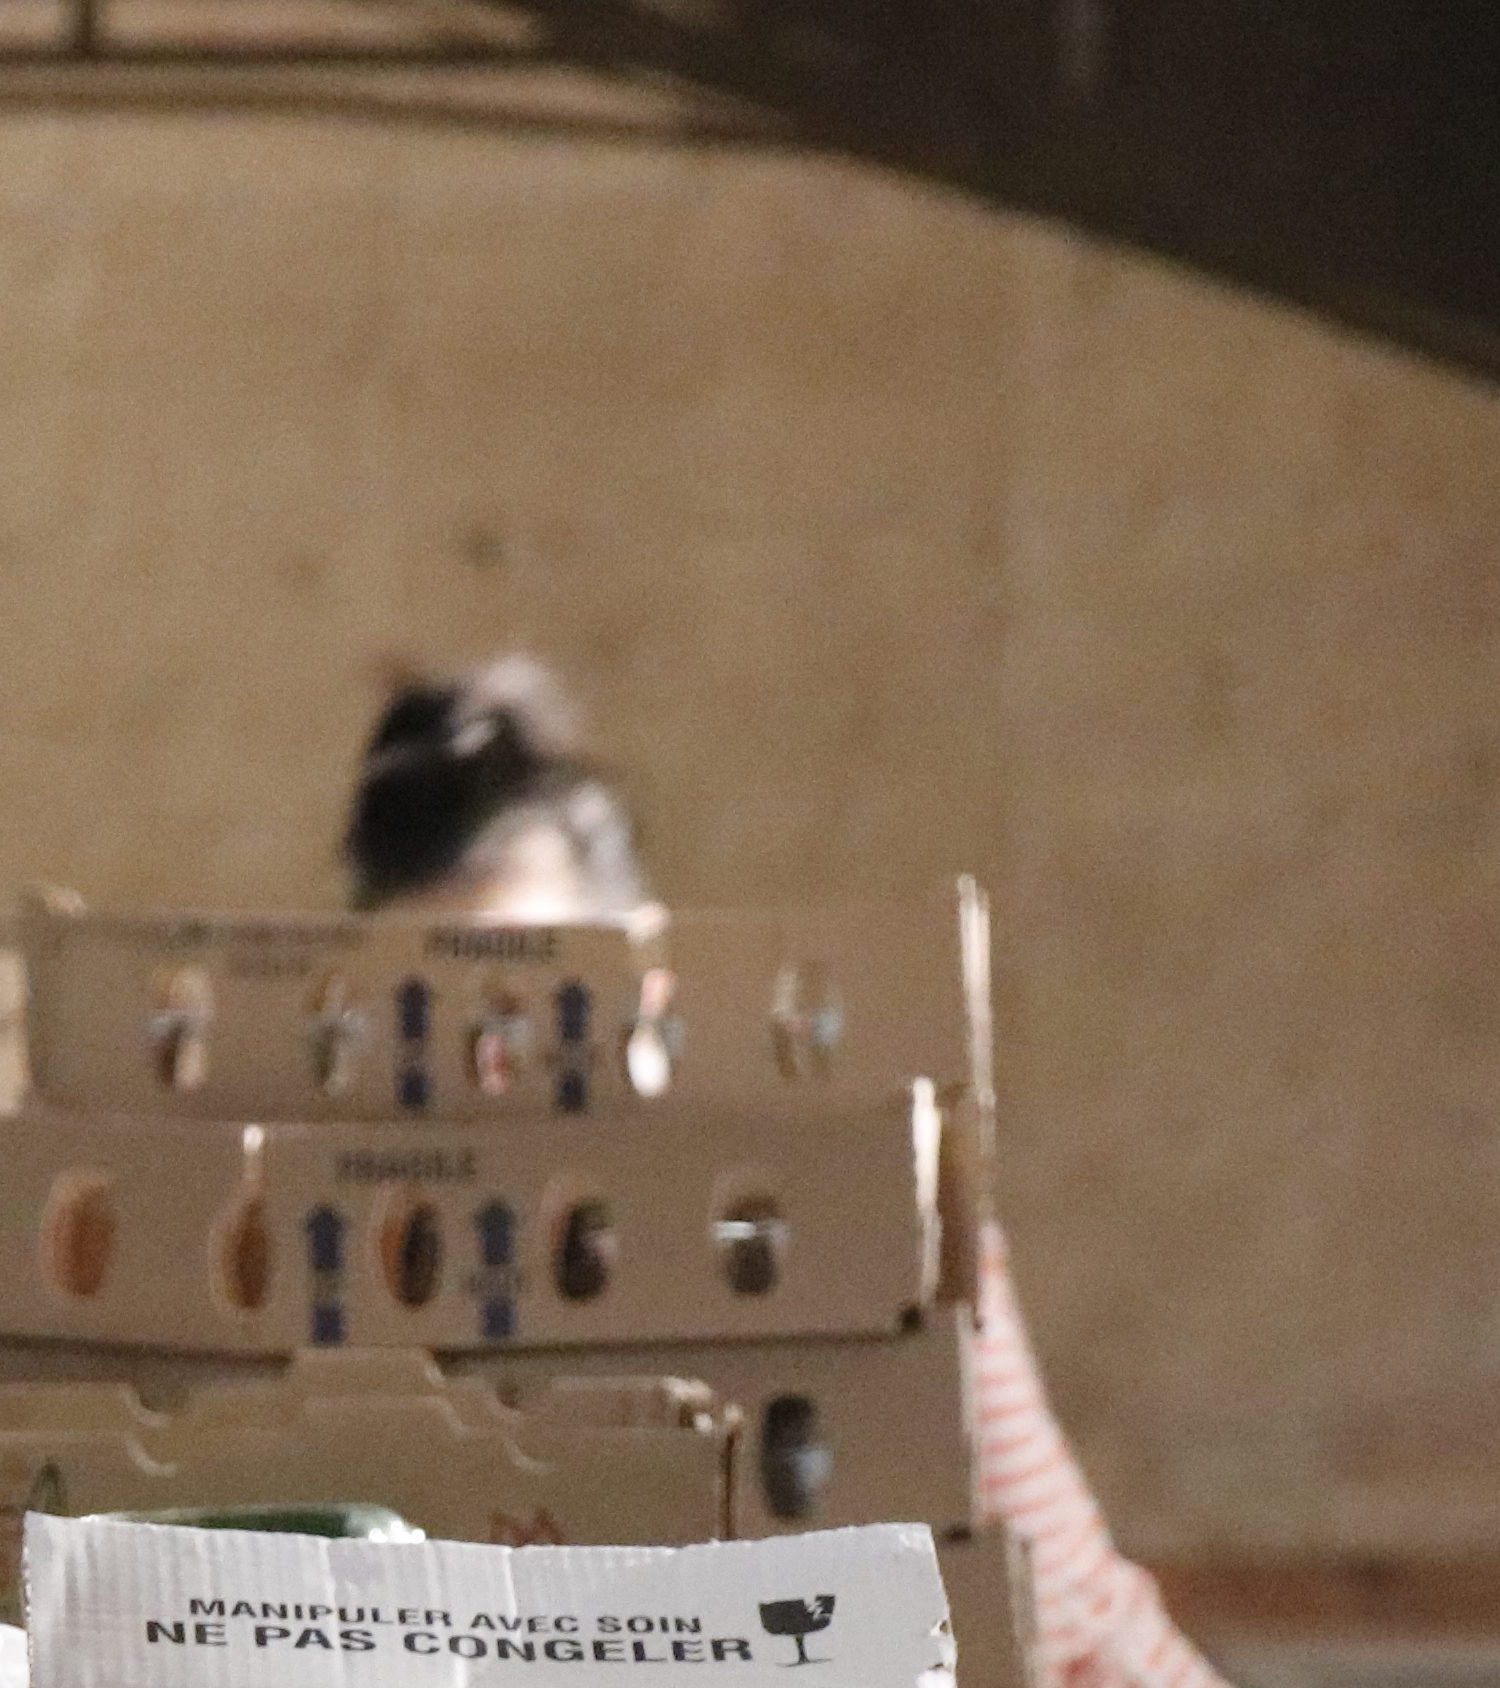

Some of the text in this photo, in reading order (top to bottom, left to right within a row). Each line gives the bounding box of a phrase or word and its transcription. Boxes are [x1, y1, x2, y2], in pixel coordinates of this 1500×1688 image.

[189, 1597, 702, 1634] MANIPULER AVEC SOIN
[146, 1620, 755, 1664] NE PAS CONGELER
